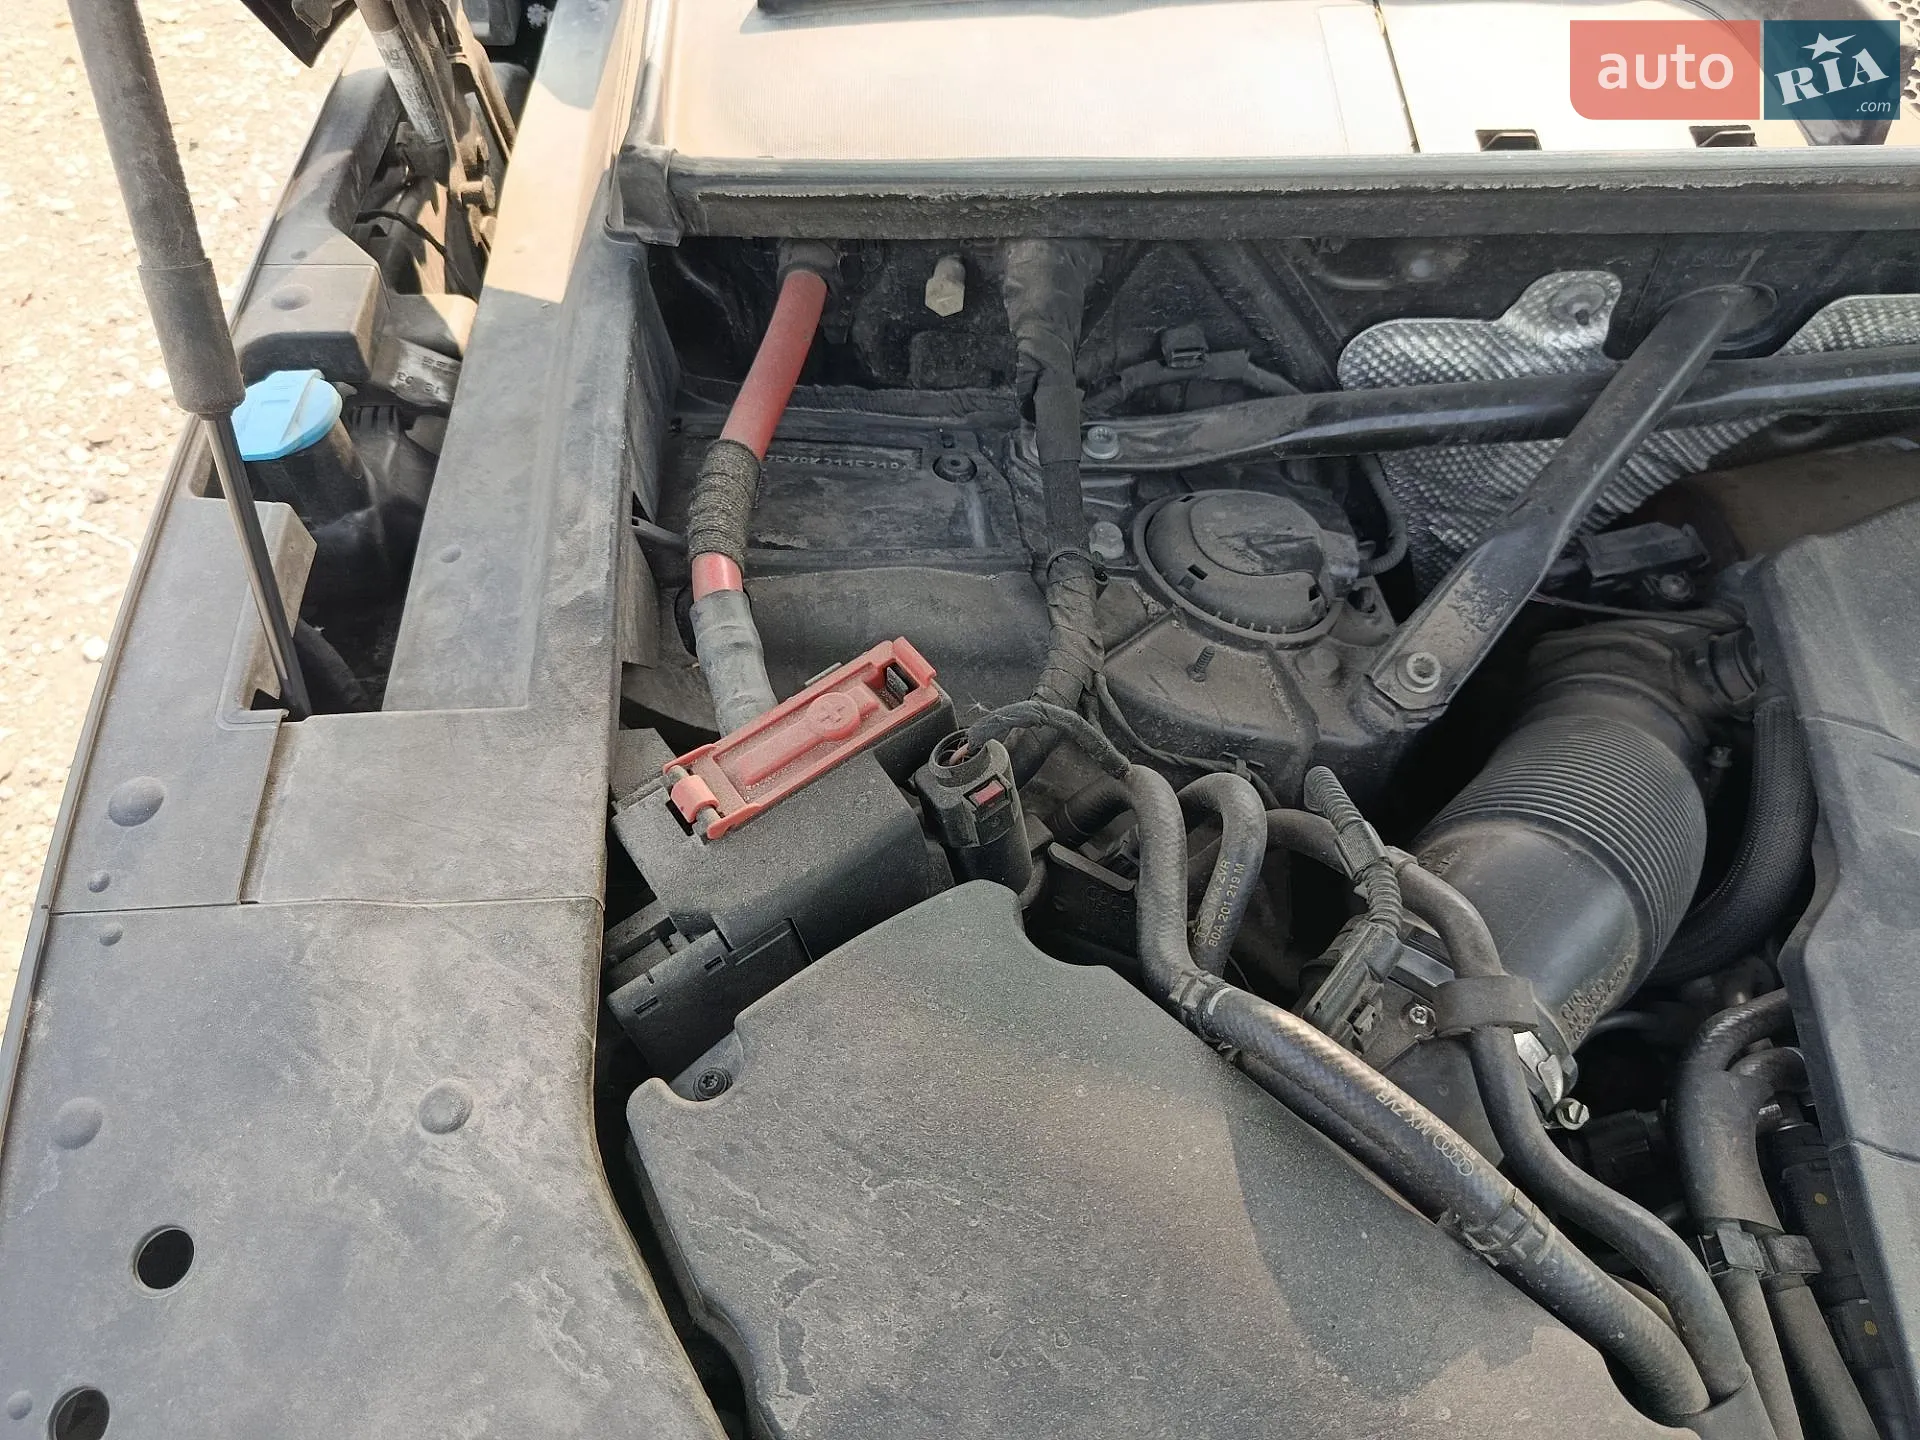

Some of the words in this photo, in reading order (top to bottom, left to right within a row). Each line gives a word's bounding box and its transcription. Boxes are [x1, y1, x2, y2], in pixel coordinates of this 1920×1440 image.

[1208, 925, 1225, 947] 80A
[1218, 901, 1233, 922] 201
[1227, 876, 1241, 898] 219
[1234, 863, 1245, 874] M
[1375, 1091, 1407, 1117] ZVR
